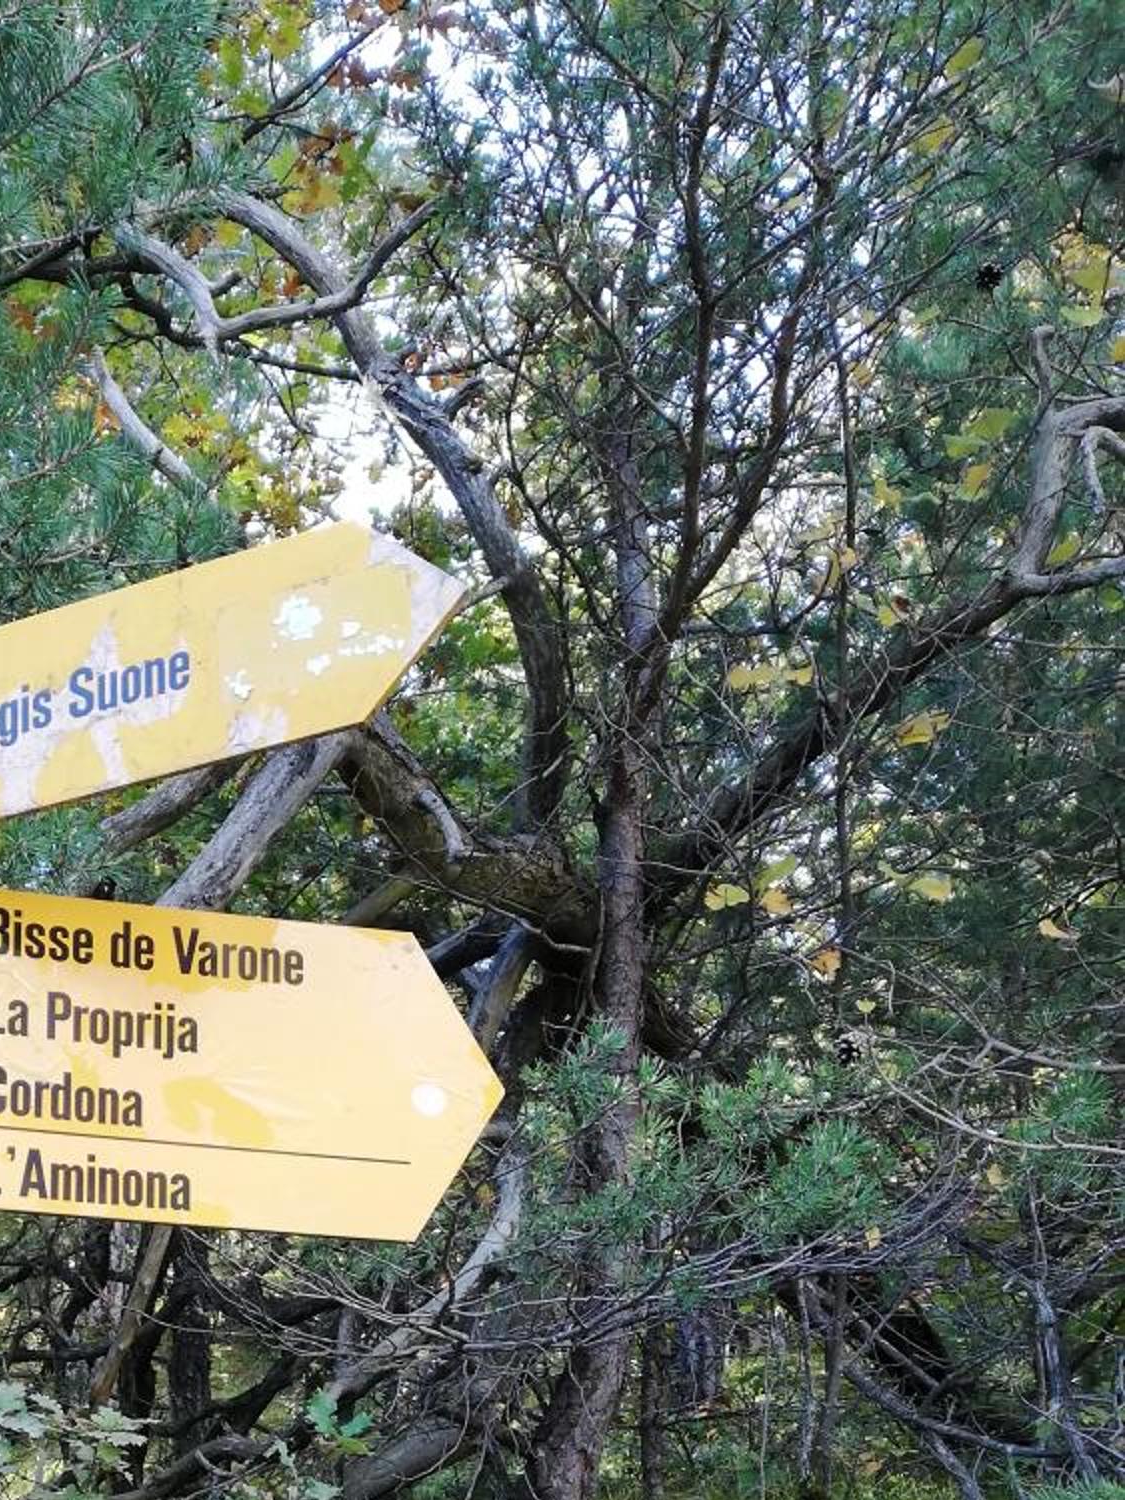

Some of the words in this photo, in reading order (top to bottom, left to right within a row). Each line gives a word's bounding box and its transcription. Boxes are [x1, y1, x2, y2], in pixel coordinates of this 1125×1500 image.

[67, 649, 191, 718] Suone
[110, 921, 154, 971] de
[172, 926, 304, 985] Varone
[46, 991, 198, 1060] Proprija
